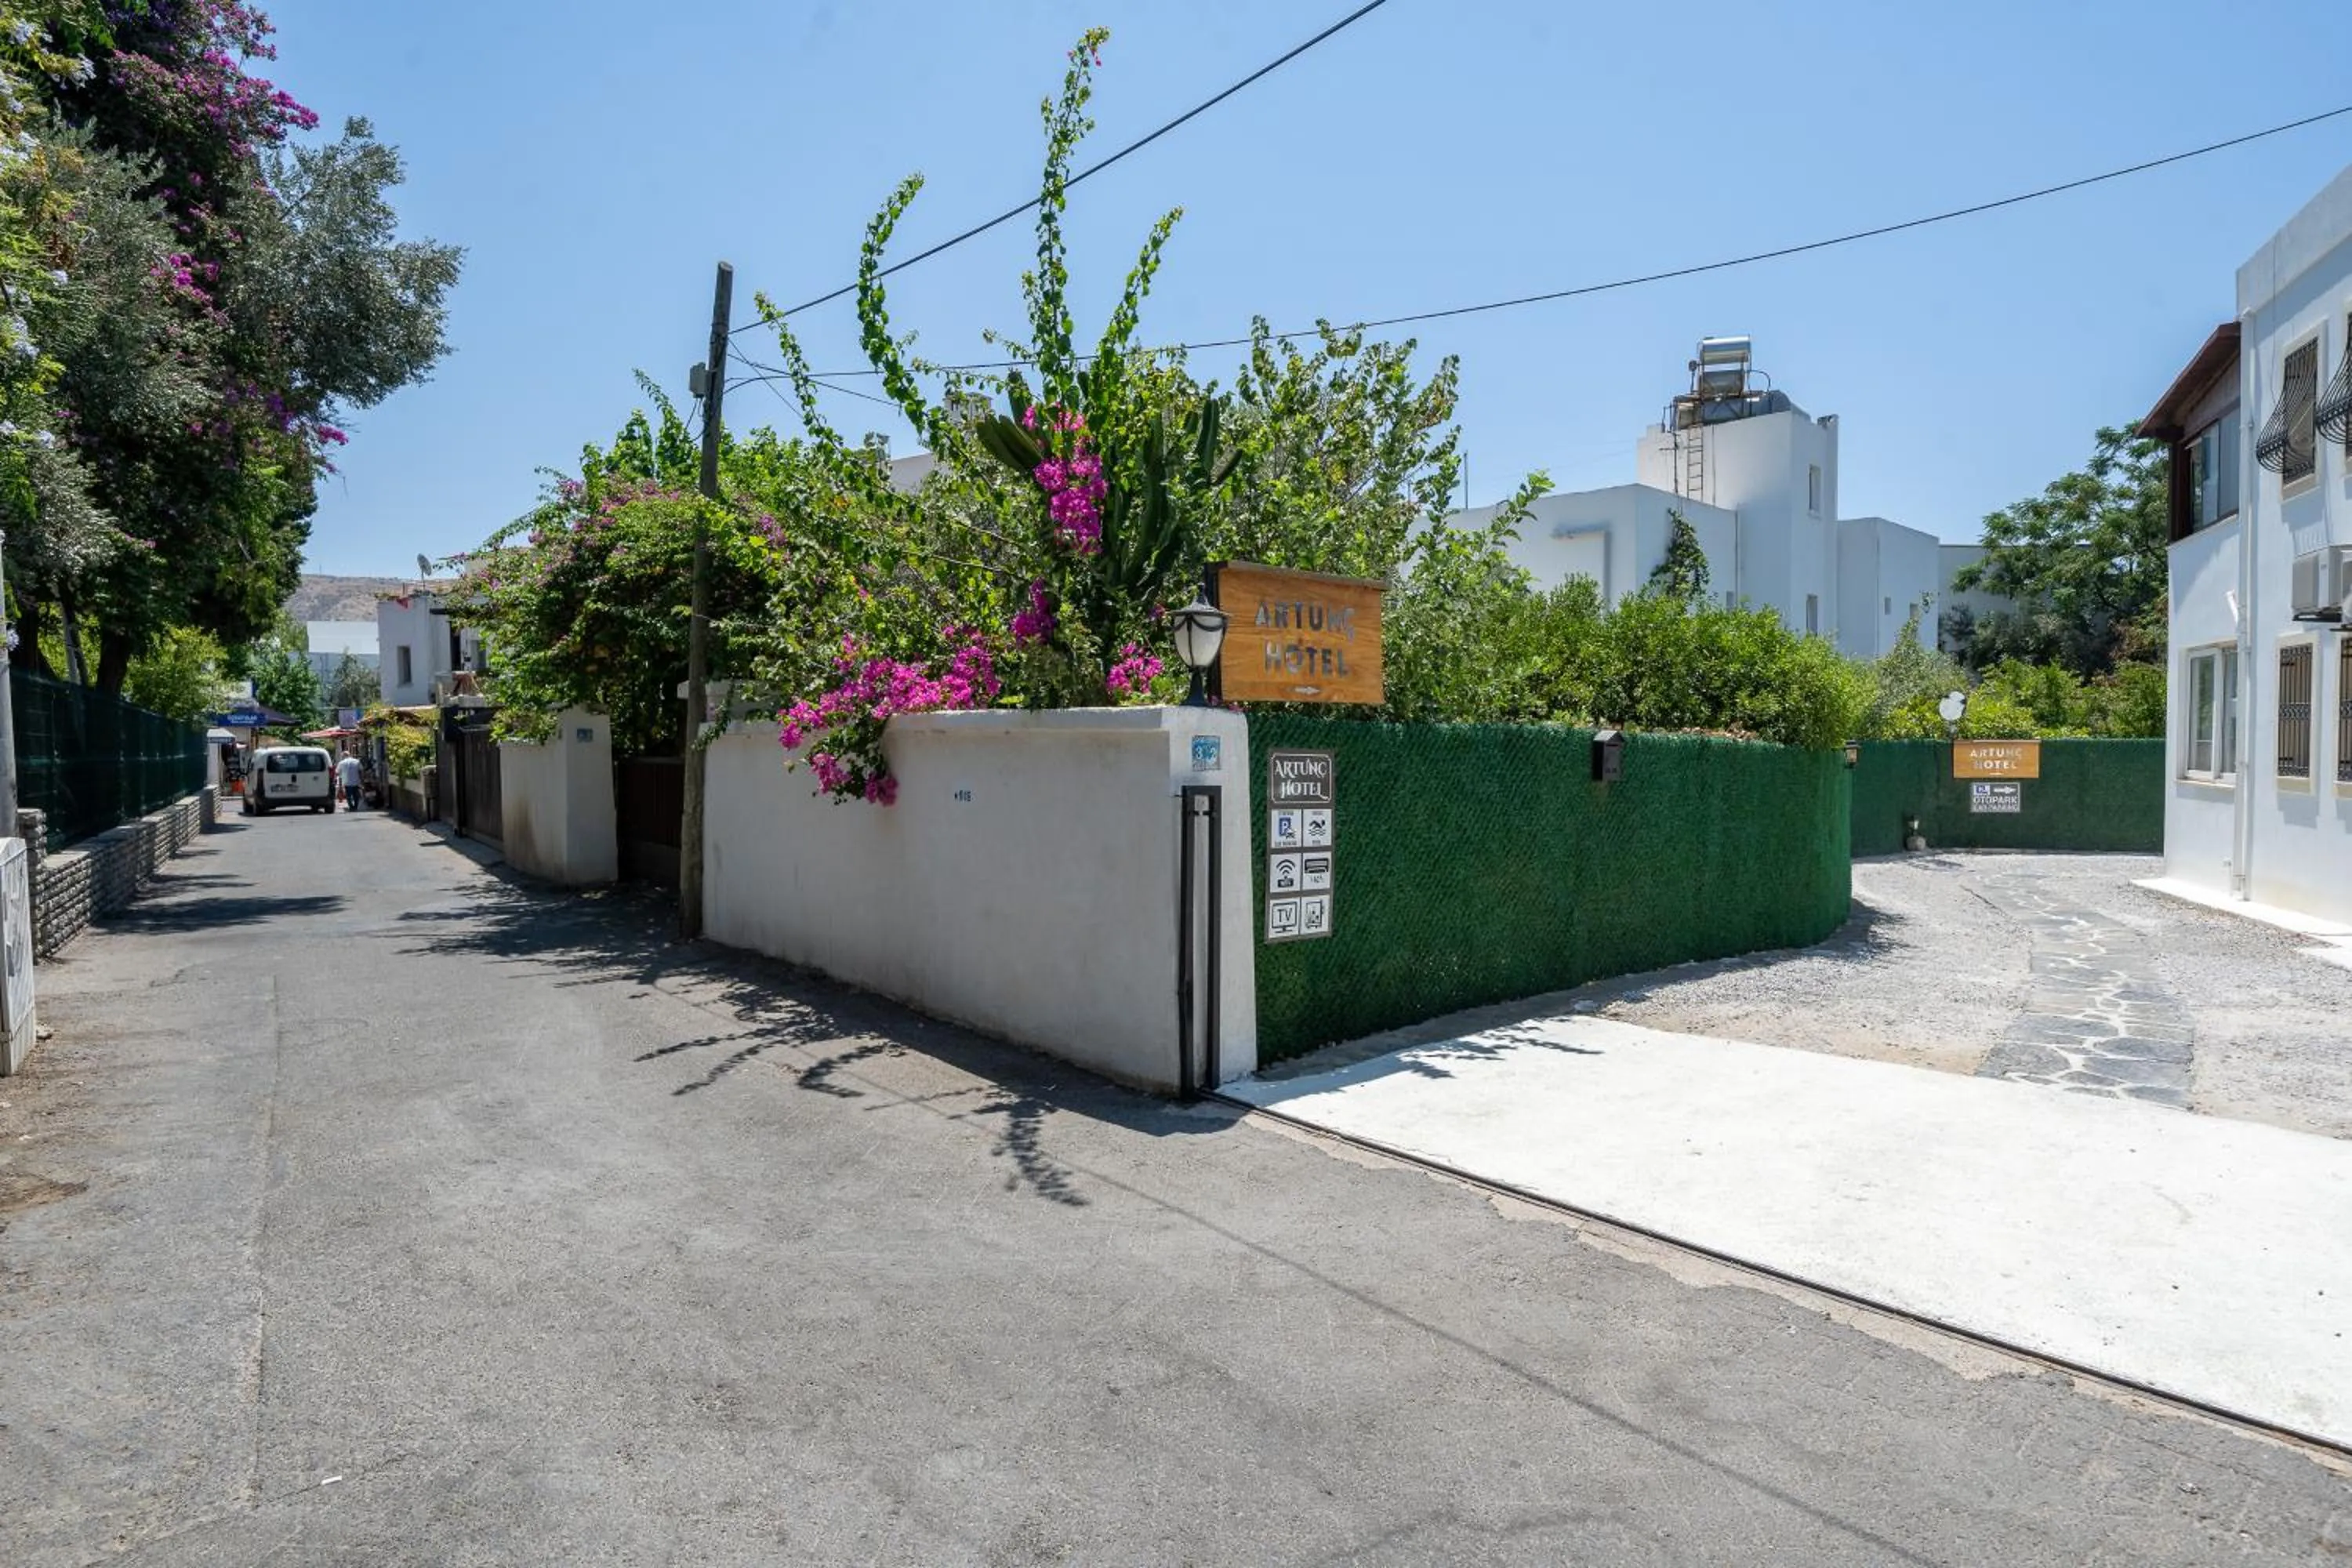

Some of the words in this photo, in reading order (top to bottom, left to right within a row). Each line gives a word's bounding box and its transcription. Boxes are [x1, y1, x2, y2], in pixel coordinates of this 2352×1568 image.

[1265, 638, 1351, 678] HOTEL
[1274, 758, 1328, 779] ARTUNÇ
[1973, 760, 2017, 769] HOTEL
[1279, 779, 1329, 800] HOTEL
[1277, 907, 1293, 923] TV
